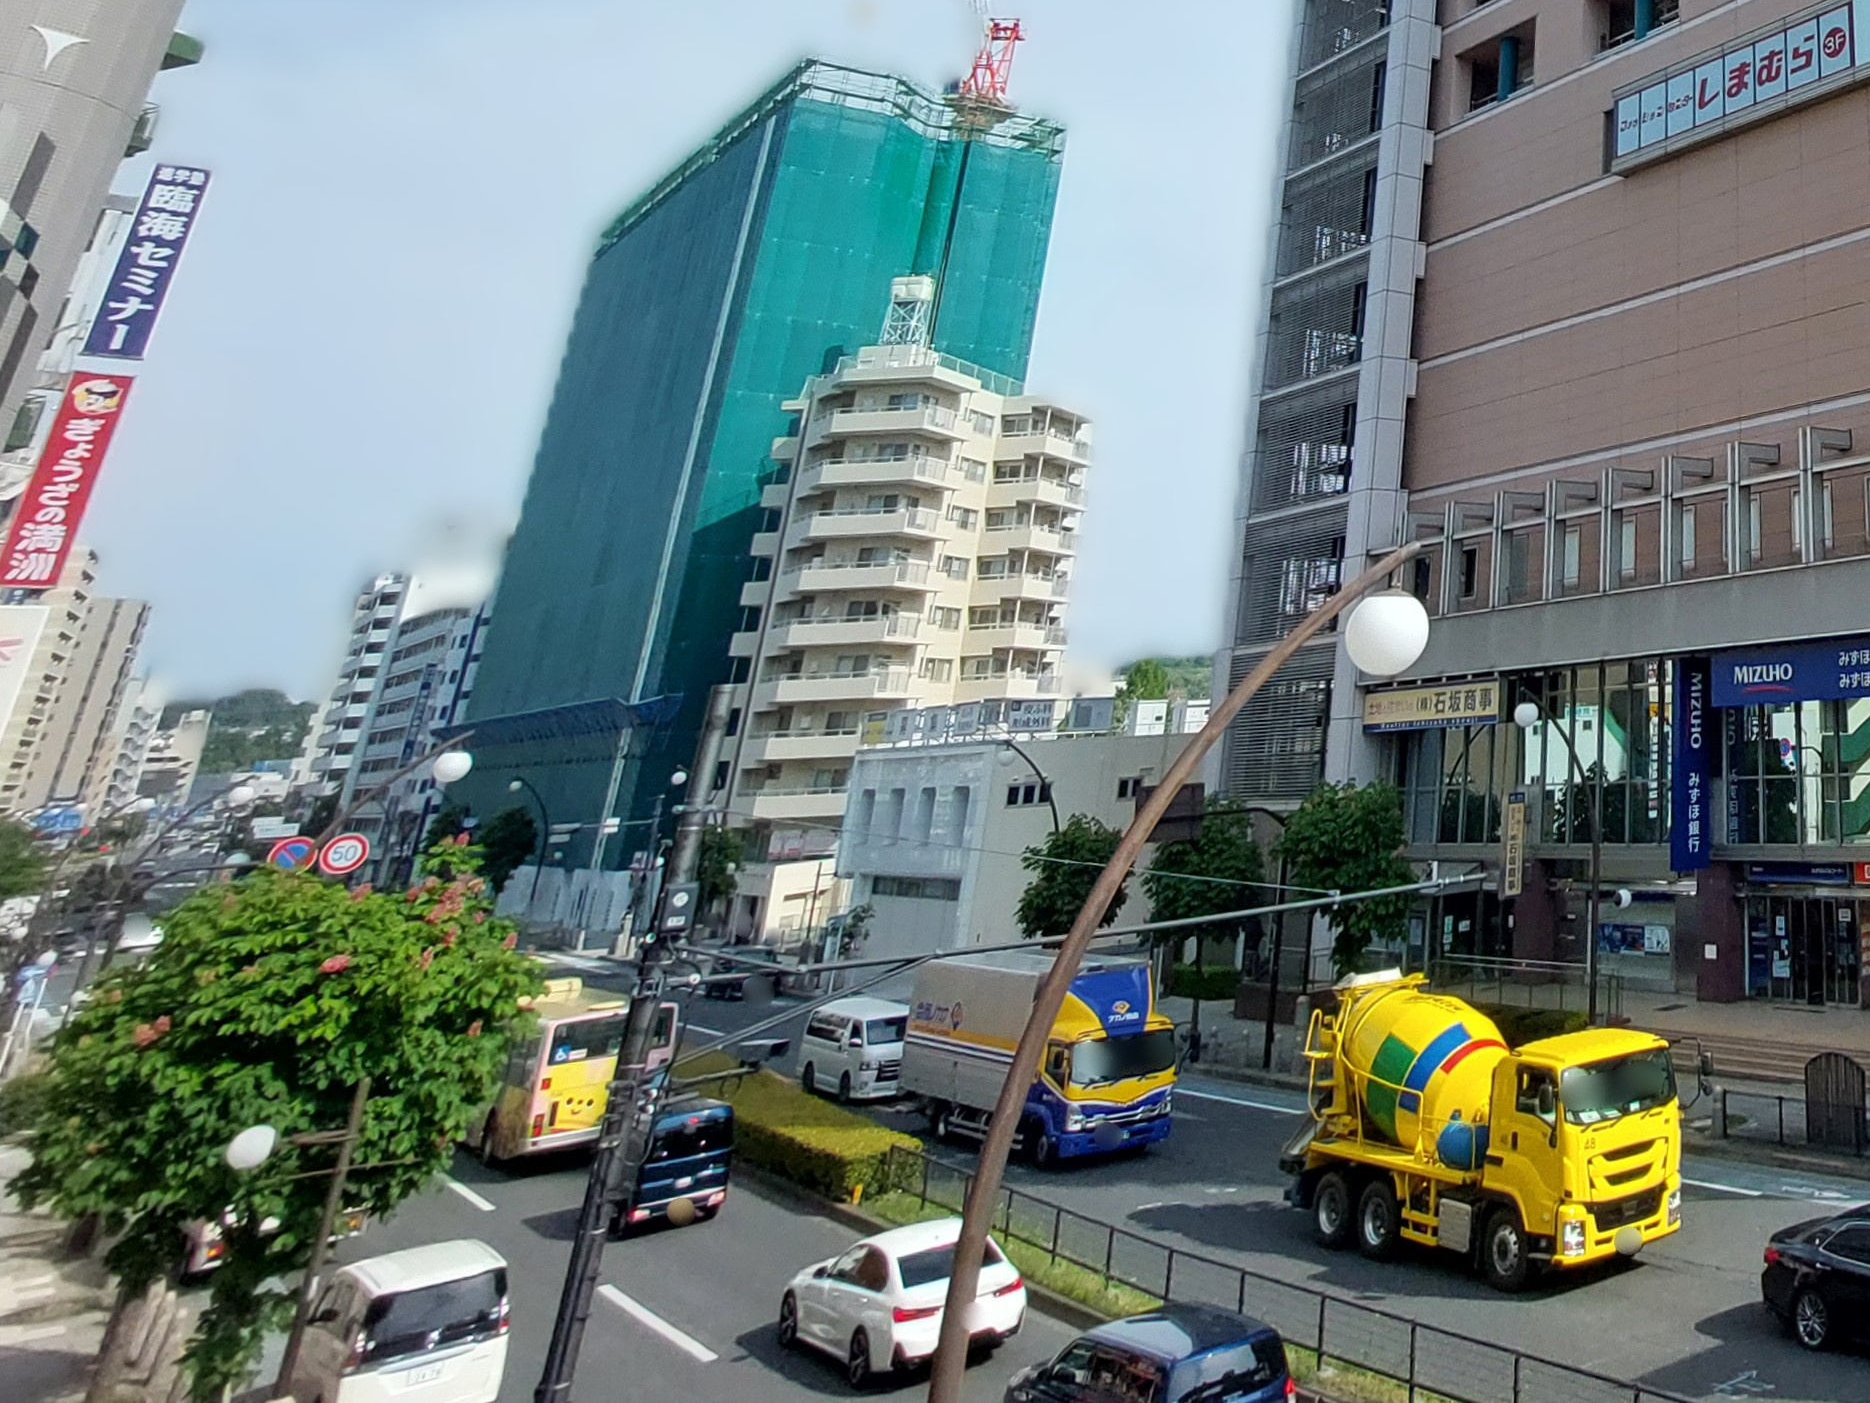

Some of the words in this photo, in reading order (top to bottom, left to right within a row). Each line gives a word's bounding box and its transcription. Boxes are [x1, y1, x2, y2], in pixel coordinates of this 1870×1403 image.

[1697, 35, 1816, 110] しまむら
[1823, 32, 1846, 55] 3F
[107, 184, 200, 351] 臨海セミナー
[1690, 671, 1703, 750] MIZUHO
[1733, 662, 1793, 686] MIZUHO
[1687, 771, 1702, 854] みずほ銀行
[330, 844, 358, 863] 50
